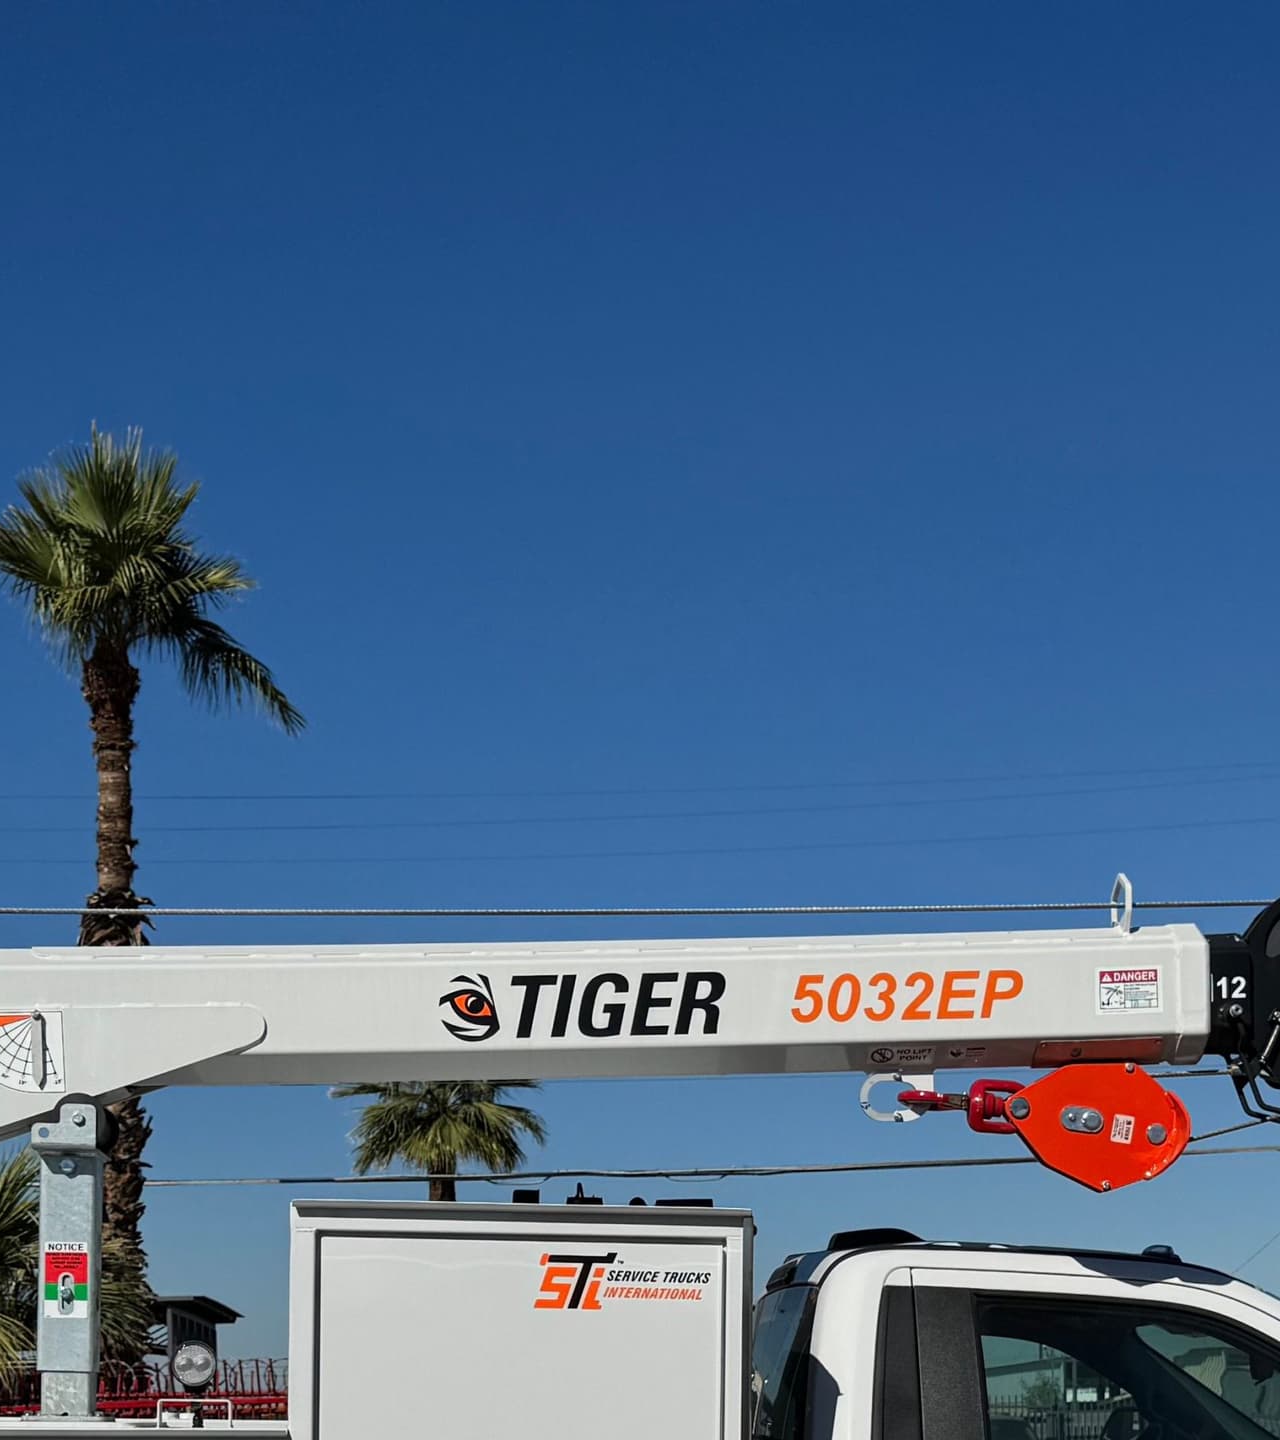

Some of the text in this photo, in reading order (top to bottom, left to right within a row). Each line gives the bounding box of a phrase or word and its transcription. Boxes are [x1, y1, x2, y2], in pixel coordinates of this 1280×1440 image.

[1113, 971, 1156, 982] DANGER
[1216, 976, 1247, 999] 12
[791, 969, 1025, 1024] 5032EP
[510, 971, 727, 1038] TIGER
[898, 1054, 927, 1062] POINT
[912, 1047, 933, 1055] LIFT
[48, 1243, 85, 1252] NOTICE
[607, 1270, 712, 1284] SERVICE TRUCKS
[603, 1286, 704, 1301] INTERNATIONAL
